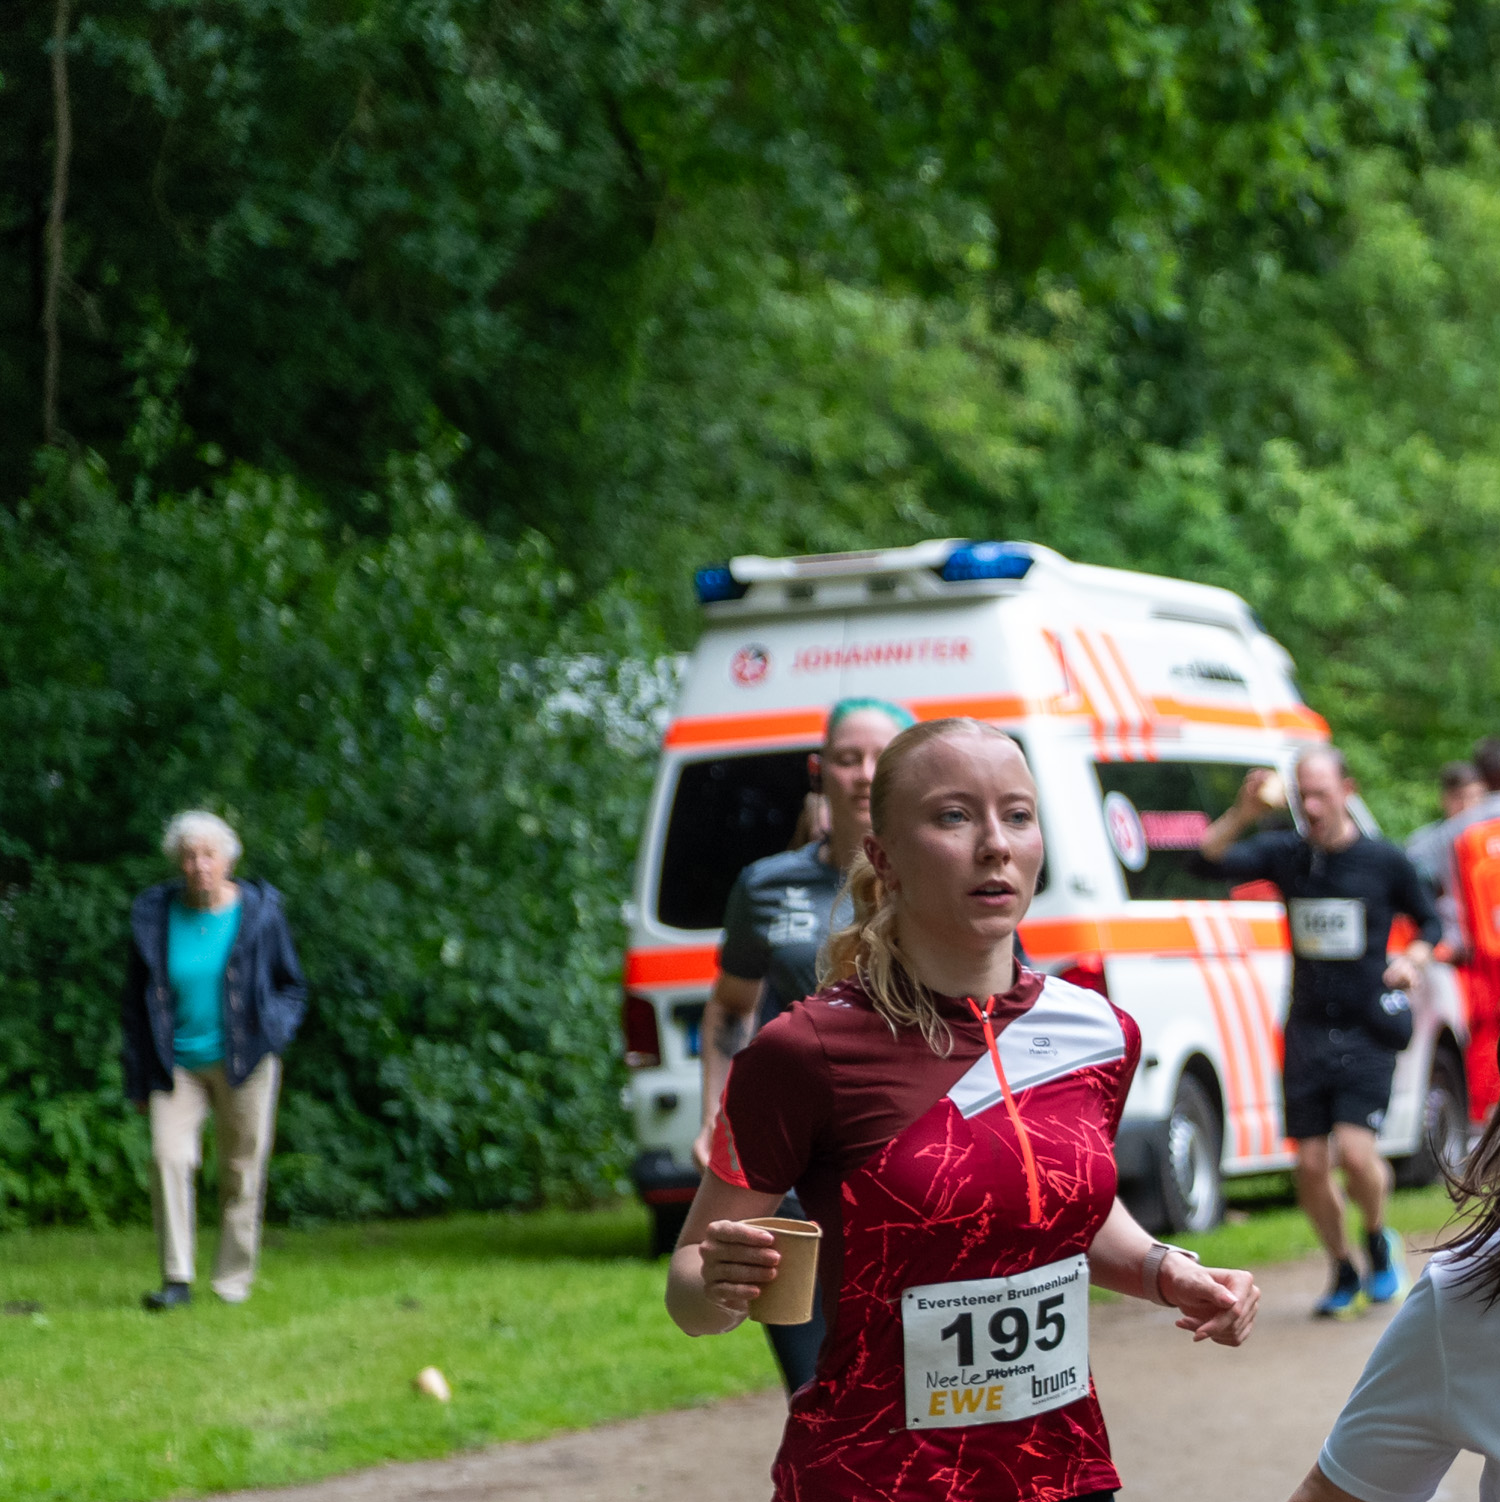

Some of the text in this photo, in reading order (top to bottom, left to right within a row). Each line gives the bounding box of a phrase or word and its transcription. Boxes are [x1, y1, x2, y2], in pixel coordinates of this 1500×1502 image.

[917, 1269, 1080, 1310] Everstener Brunnenlauf
[940, 1293, 1066, 1367] 195
[926, 1368, 988, 1389] Neele
[1031, 1366, 1077, 1399] bruns
[928, 1385, 1004, 1416] EWE
